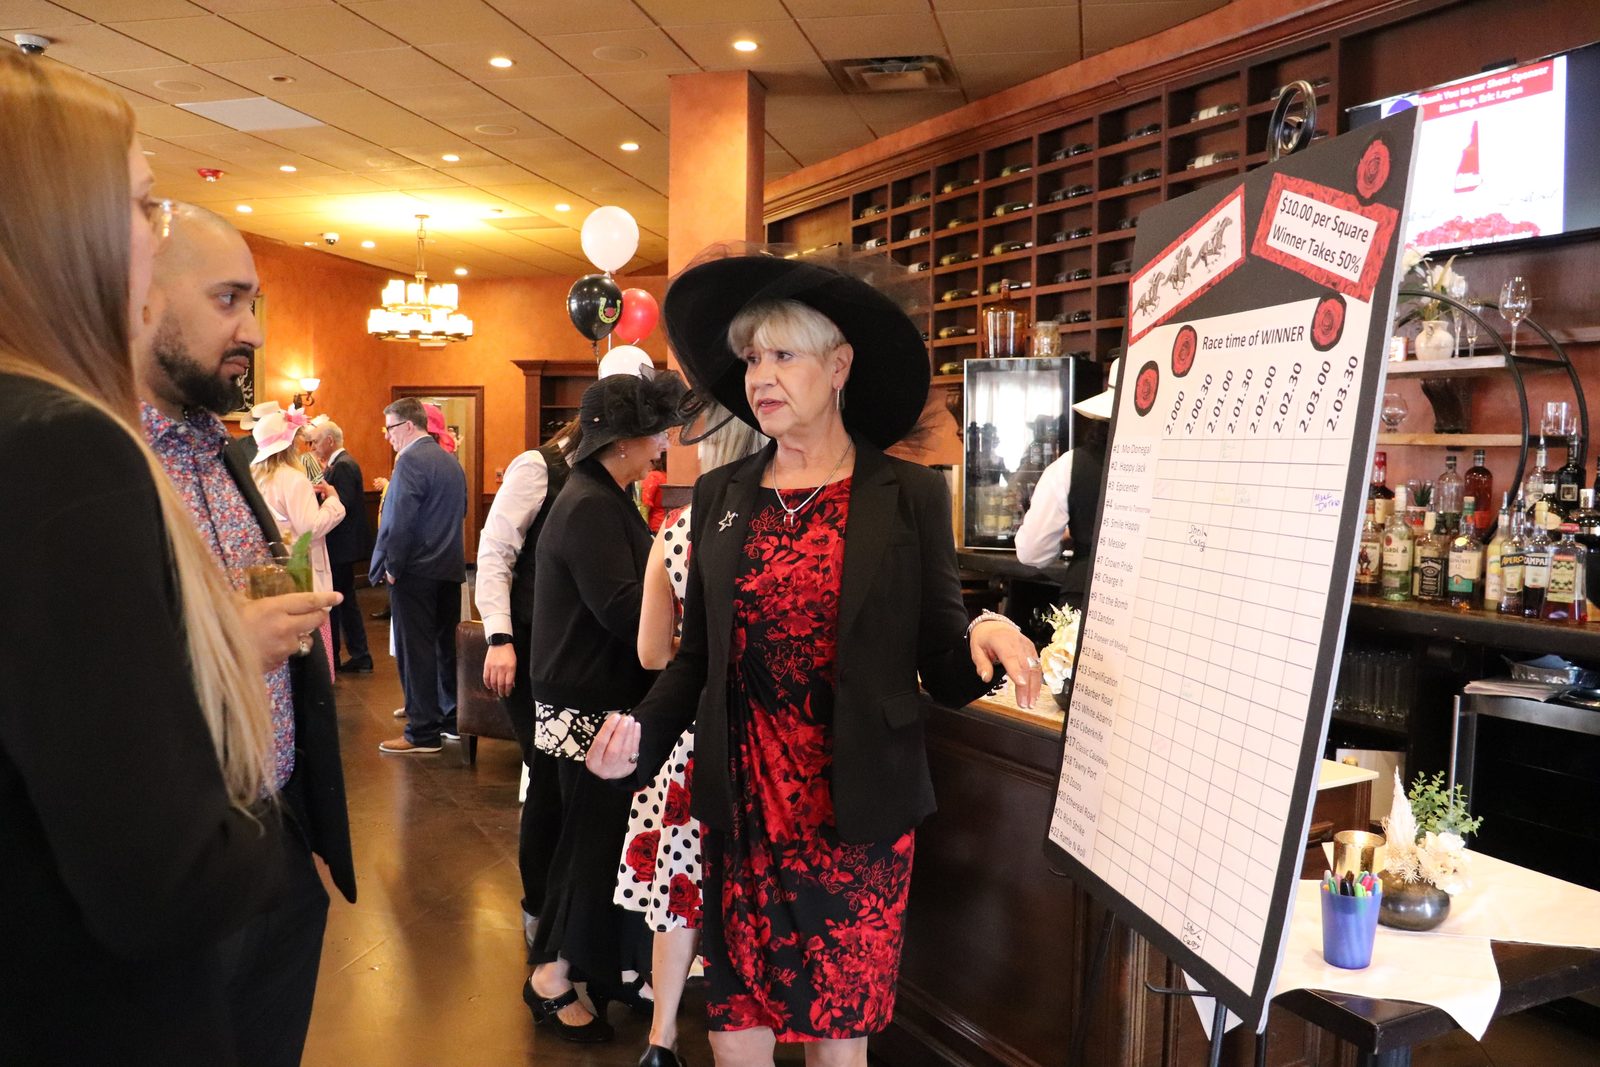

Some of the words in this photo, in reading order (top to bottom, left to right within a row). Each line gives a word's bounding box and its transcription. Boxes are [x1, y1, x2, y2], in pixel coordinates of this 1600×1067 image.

[1460, 87, 1470, 96] to
[1280, 195, 1313, 221] $10.00
[1312, 214, 1331, 228] per
[1331, 215, 1369, 243] Square
[1272, 224, 1306, 251] Winner
[1308, 238, 1336, 264] Takes
[1337, 250, 1361, 274] 50%
[1202, 336, 1222, 350] Race
[1225, 333, 1246, 349] time
[1248, 332, 1260, 346] of
[1261, 326, 1304, 345] WINNER
[1185, 373, 1213, 435] 2.00.30
[1206, 369, 1234, 434] 2.01.00
[1227, 368, 1254, 434] 2.01.30
[1249, 365, 1277, 434] 2.02.00
[1273, 362, 1302, 433] 2.02.30
[1299, 360, 1332, 433] 2.03.00
[1326, 355, 1359, 432] 2.03.30
[1165, 390, 1185, 435] 2.000
[1113, 444, 1120, 454] #1
[1130, 444, 1151, 456] Donegal
[1111, 461, 1118, 471] #2
[1108, 481, 1115, 490] #3
[1106, 498, 1113, 508] #4
[1103, 518, 1109, 527] #5
[1124, 522, 1140, 534] Happy
[1105, 557, 1120, 568] Crown
[1121, 560, 1133, 572] Pride
[1502, 555, 1524, 565] APERO
[1103, 573, 1119, 588] Charge
[1106, 595, 1114, 607] the
[1114, 598, 1128, 610] Bomb
[1097, 612, 1115, 626] Zandon
[1078, 664, 1088, 675] #13
[1088, 667, 1118, 687] Simplification
[1075, 682, 1085, 692] #14
[1085, 686, 1101, 701] Barber
[1101, 693, 1114, 707] Road
[1072, 700, 1081, 711] #15
[1082, 704, 1096, 718] White
[1070, 718, 1080, 729] #16
[1080, 721, 1103, 743] Cyberknife
[1065, 736, 1075, 747] #17
[1075, 741, 1089, 757] Classic
[1089, 749, 1109, 769] Causeway
[1073, 758, 1088, 775] Tawny
[1088, 766, 1097, 781] Port
[1066, 794, 1085, 814] Ethereal
[1084, 807, 1096, 823] Road
